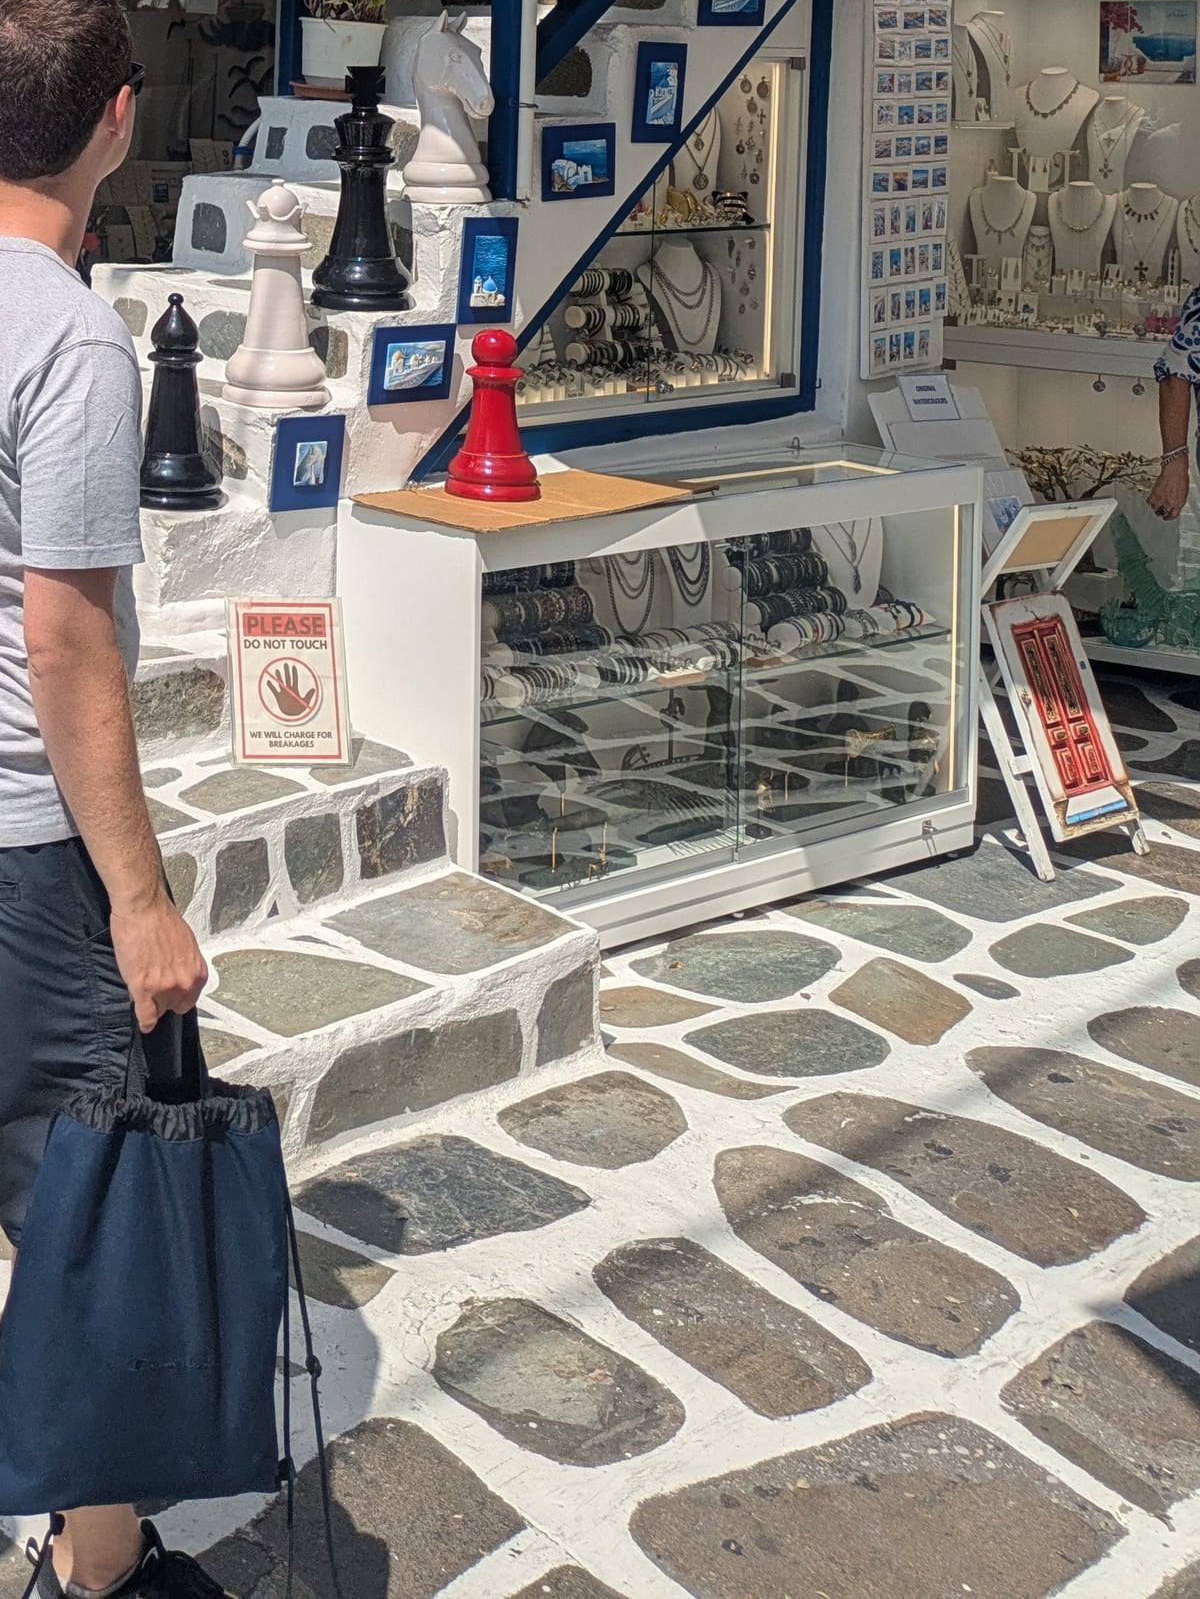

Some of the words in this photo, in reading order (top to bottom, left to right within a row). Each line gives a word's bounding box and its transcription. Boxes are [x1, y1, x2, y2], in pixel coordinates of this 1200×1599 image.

[246, 615, 324, 635] PLEASE
[243, 639, 261, 650] DO
[263, 639, 286, 650] NOT
[290, 639, 328, 650] TOUCH
[250, 731, 262, 739] WE
[263, 731, 282, 739] WILL
[283, 731, 316, 739] CHARGE
[316, 731, 333, 739] FOR
[268, 740, 316, 748] BREAKAGES
